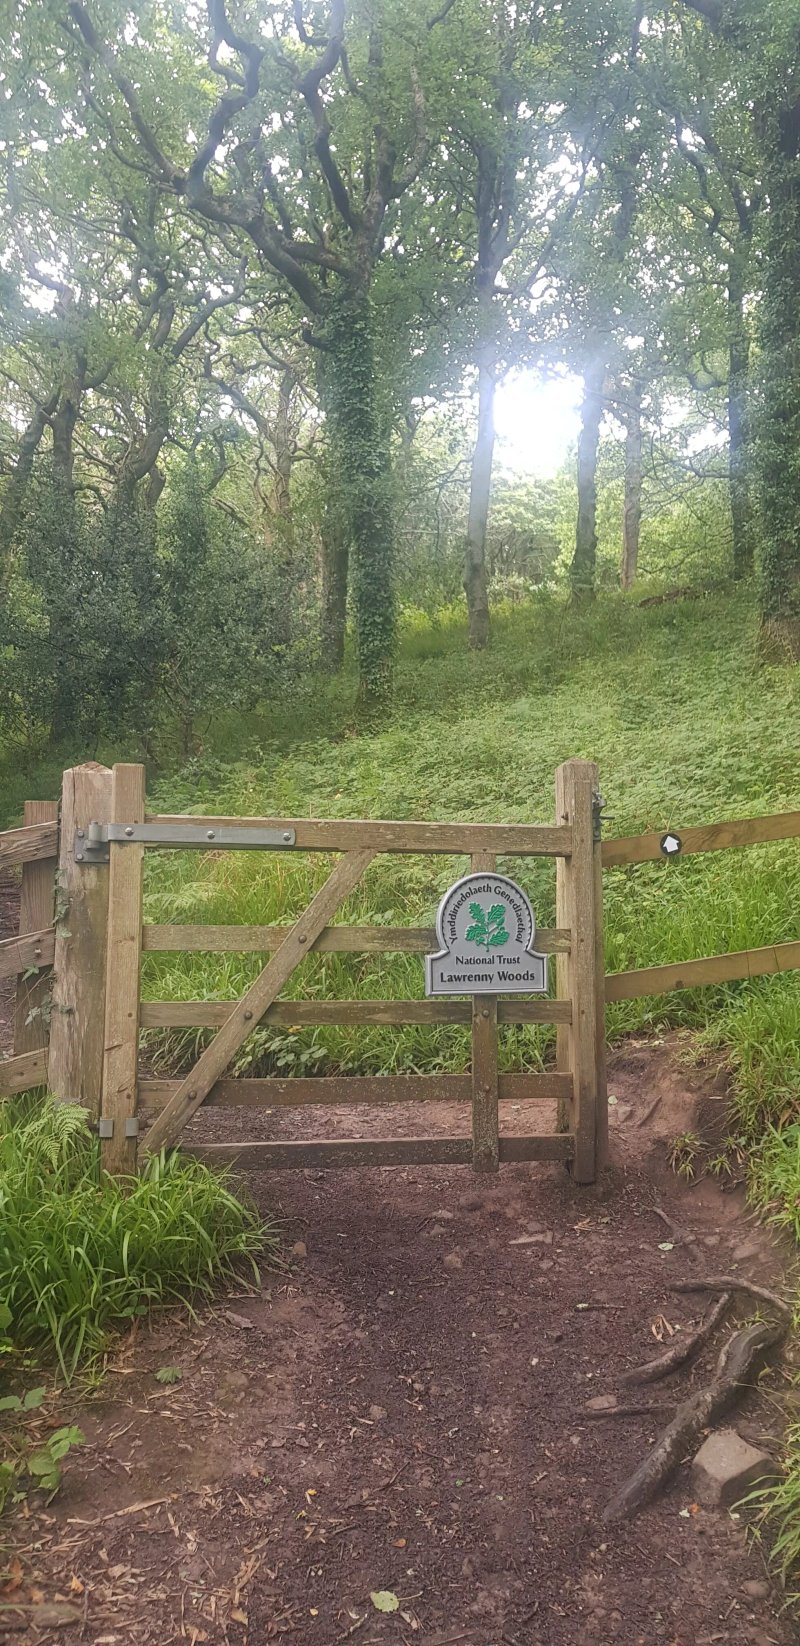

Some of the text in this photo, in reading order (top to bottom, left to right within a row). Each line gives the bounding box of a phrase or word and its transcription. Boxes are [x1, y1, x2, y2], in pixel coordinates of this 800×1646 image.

[447, 883, 526, 944] Ymddiriedolaeth Genedlaethol
[455, 955, 520, 965] National Trust
[440, 970, 535, 983] Lawrenny Woods
